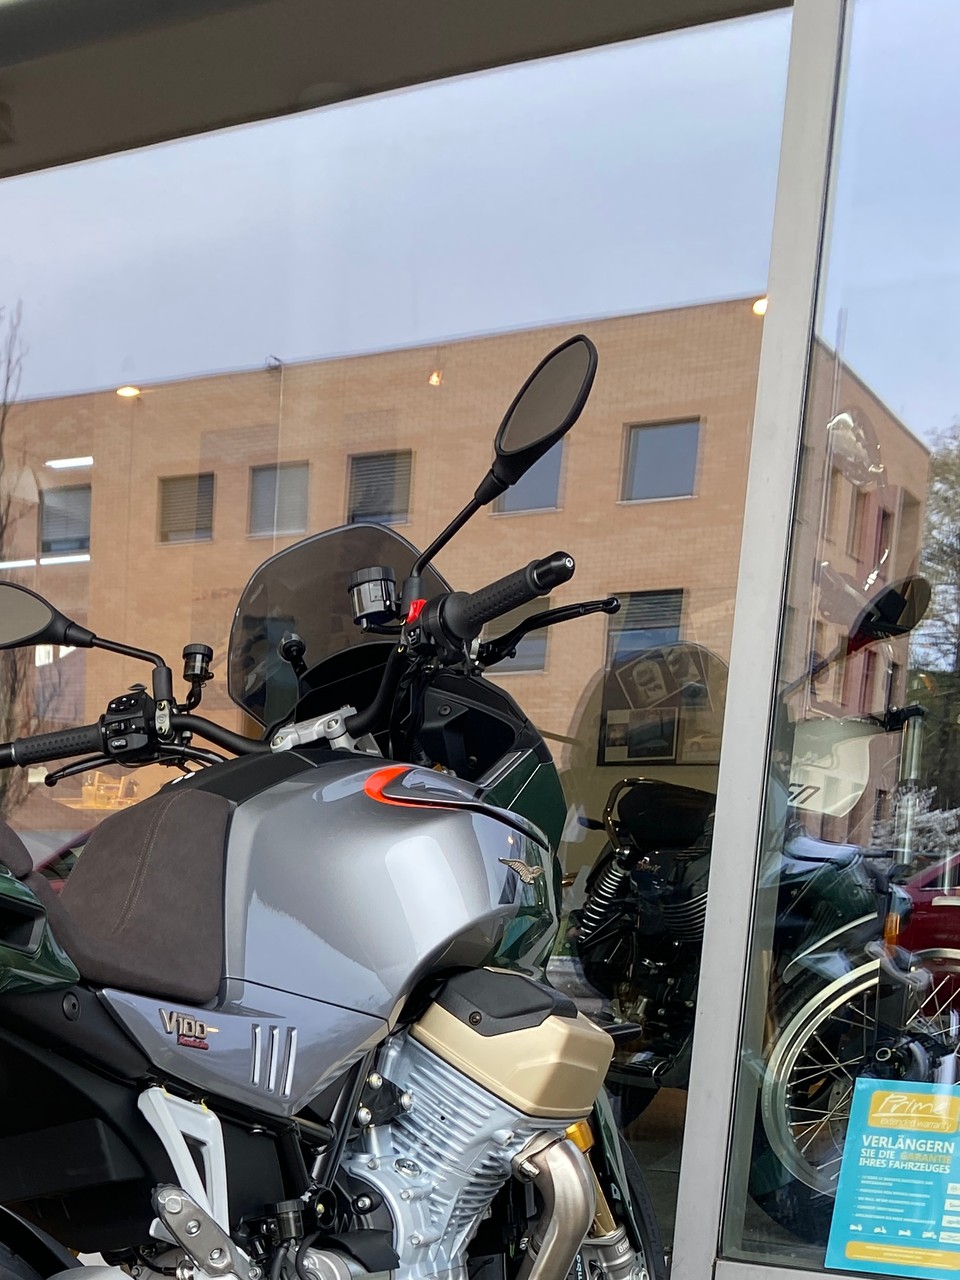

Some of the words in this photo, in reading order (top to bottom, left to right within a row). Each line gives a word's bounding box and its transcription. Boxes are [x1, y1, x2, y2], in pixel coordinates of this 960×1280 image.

[158, 1008, 208, 1040] V100
[878, 1093, 948, 1114] Prime
[880, 1118, 916, 1127] extended
[917, 1120, 952, 1132] warranty
[862, 1134, 955, 1154] VERLÄNGERN
[860, 1148, 875, 1158] SIE
[878, 1150, 896, 1159] DIE
[859, 1158, 886, 1168] IHRES
[888, 1160, 951, 1174] FAHRZEUGES
